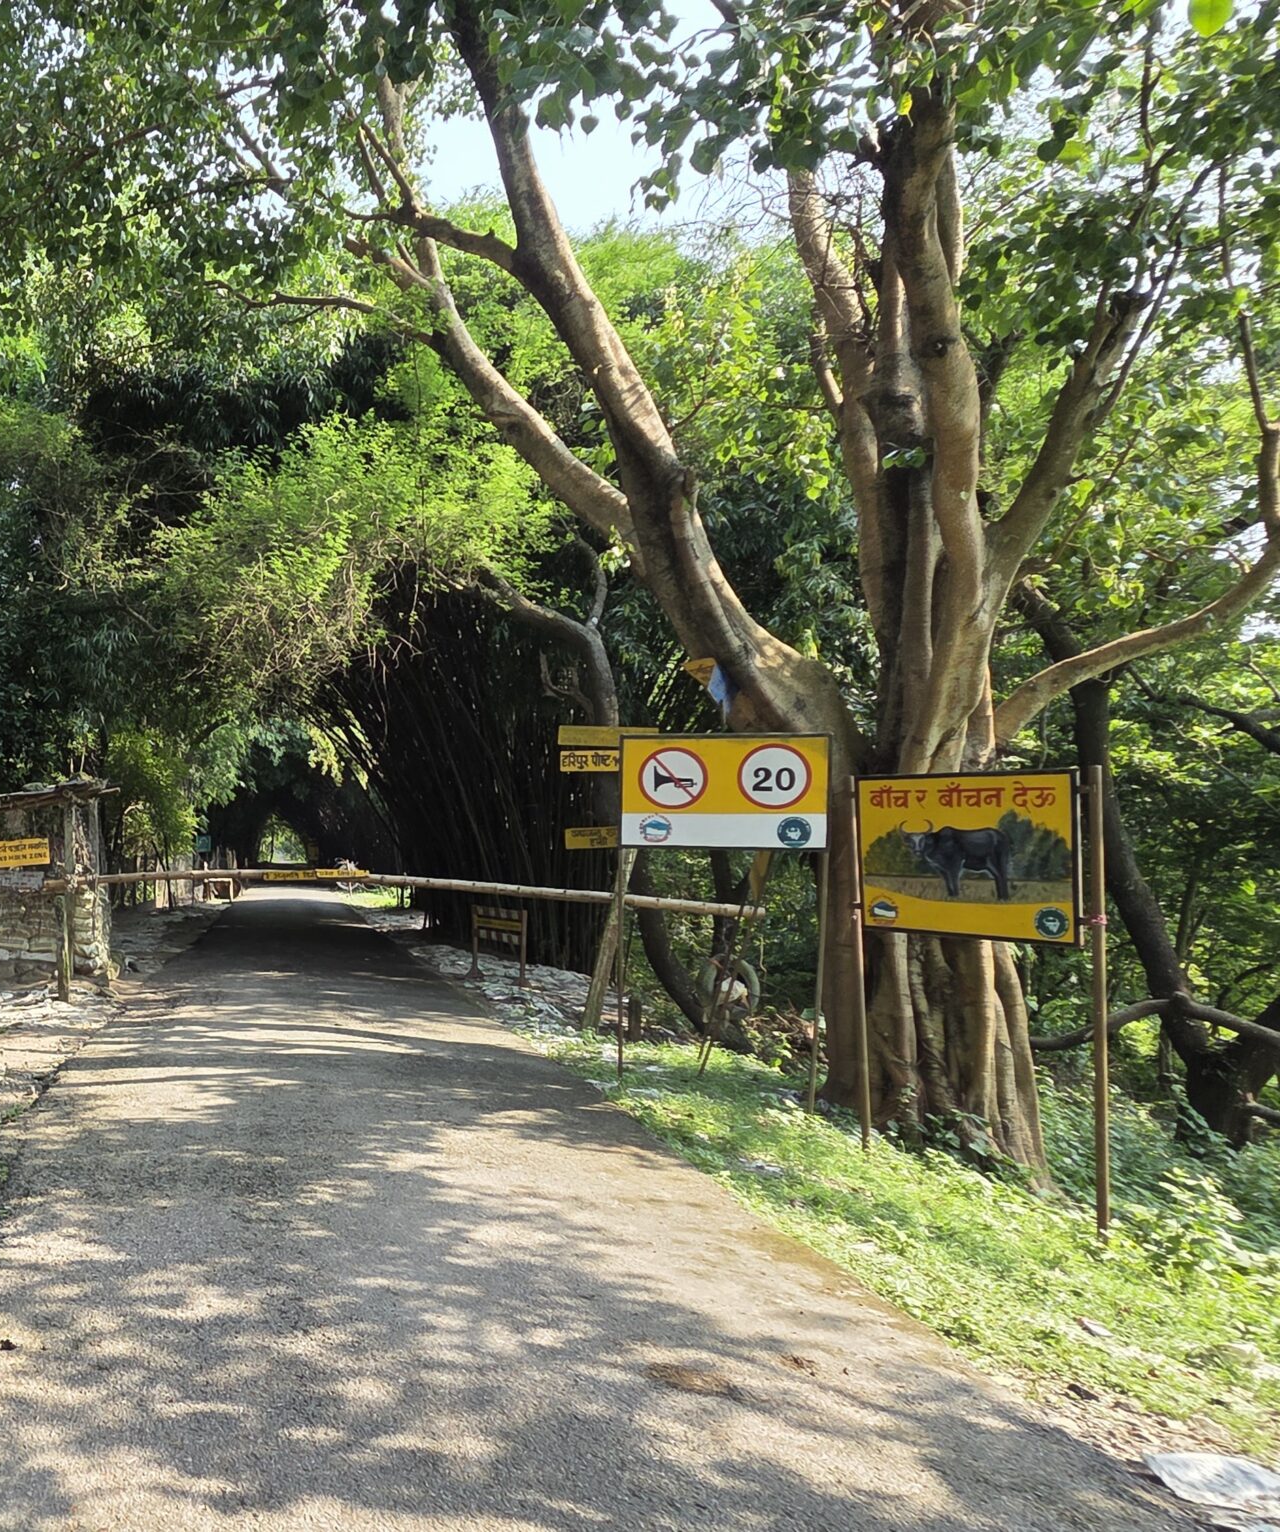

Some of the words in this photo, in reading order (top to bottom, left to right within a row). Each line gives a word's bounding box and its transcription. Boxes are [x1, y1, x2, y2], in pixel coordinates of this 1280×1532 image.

[752, 767, 795, 791] 20
[869, 785, 912, 808] बाँच
[915, 789, 928, 808] र
